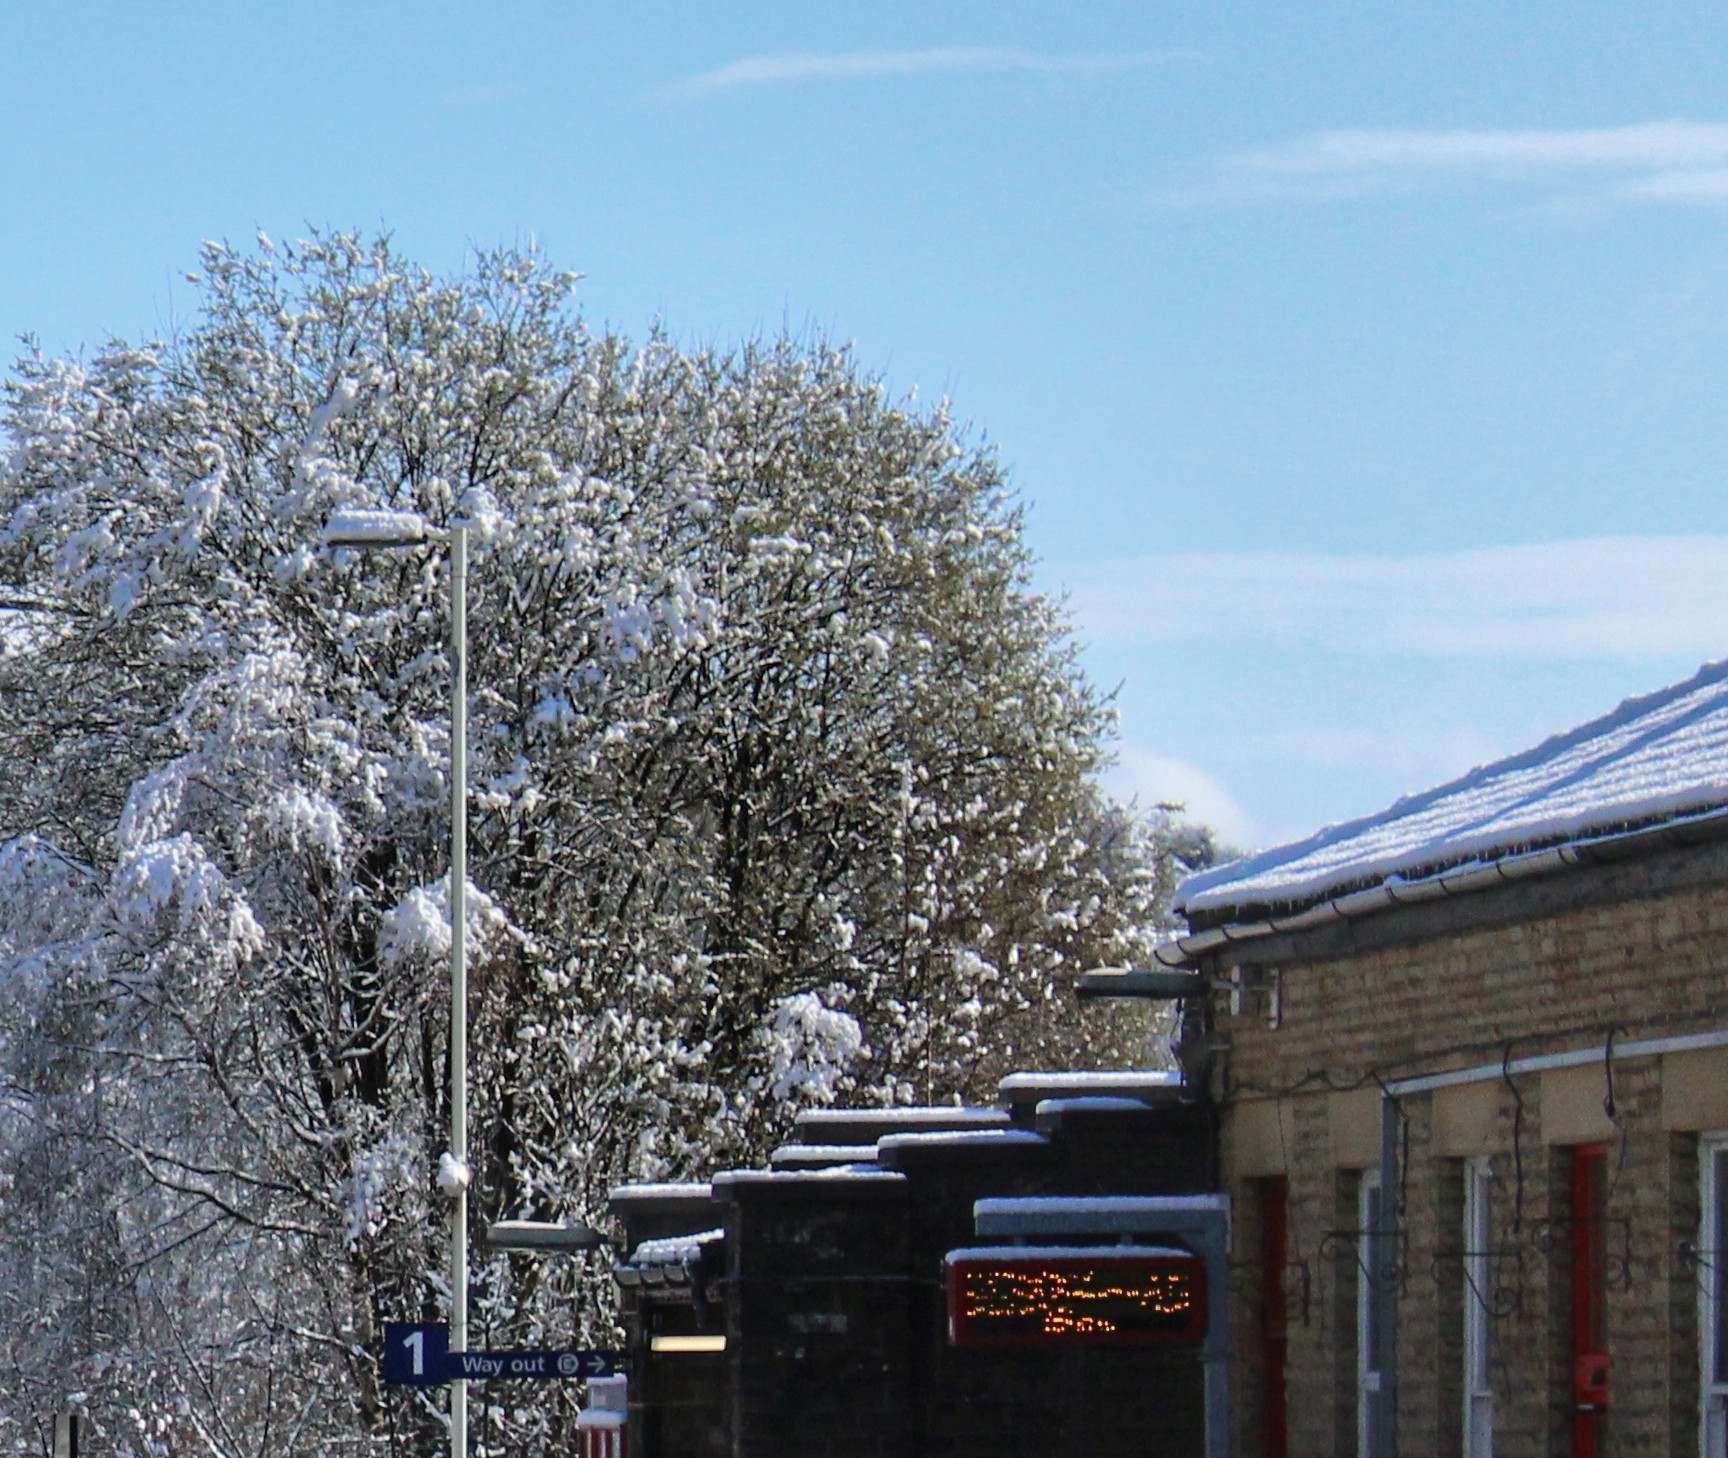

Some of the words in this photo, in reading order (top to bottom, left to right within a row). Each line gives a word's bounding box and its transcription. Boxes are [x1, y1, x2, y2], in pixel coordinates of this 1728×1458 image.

[402, 1331, 424, 1375] 1
[462, 1356, 504, 1376] Way
[511, 1357, 544, 1372] out
